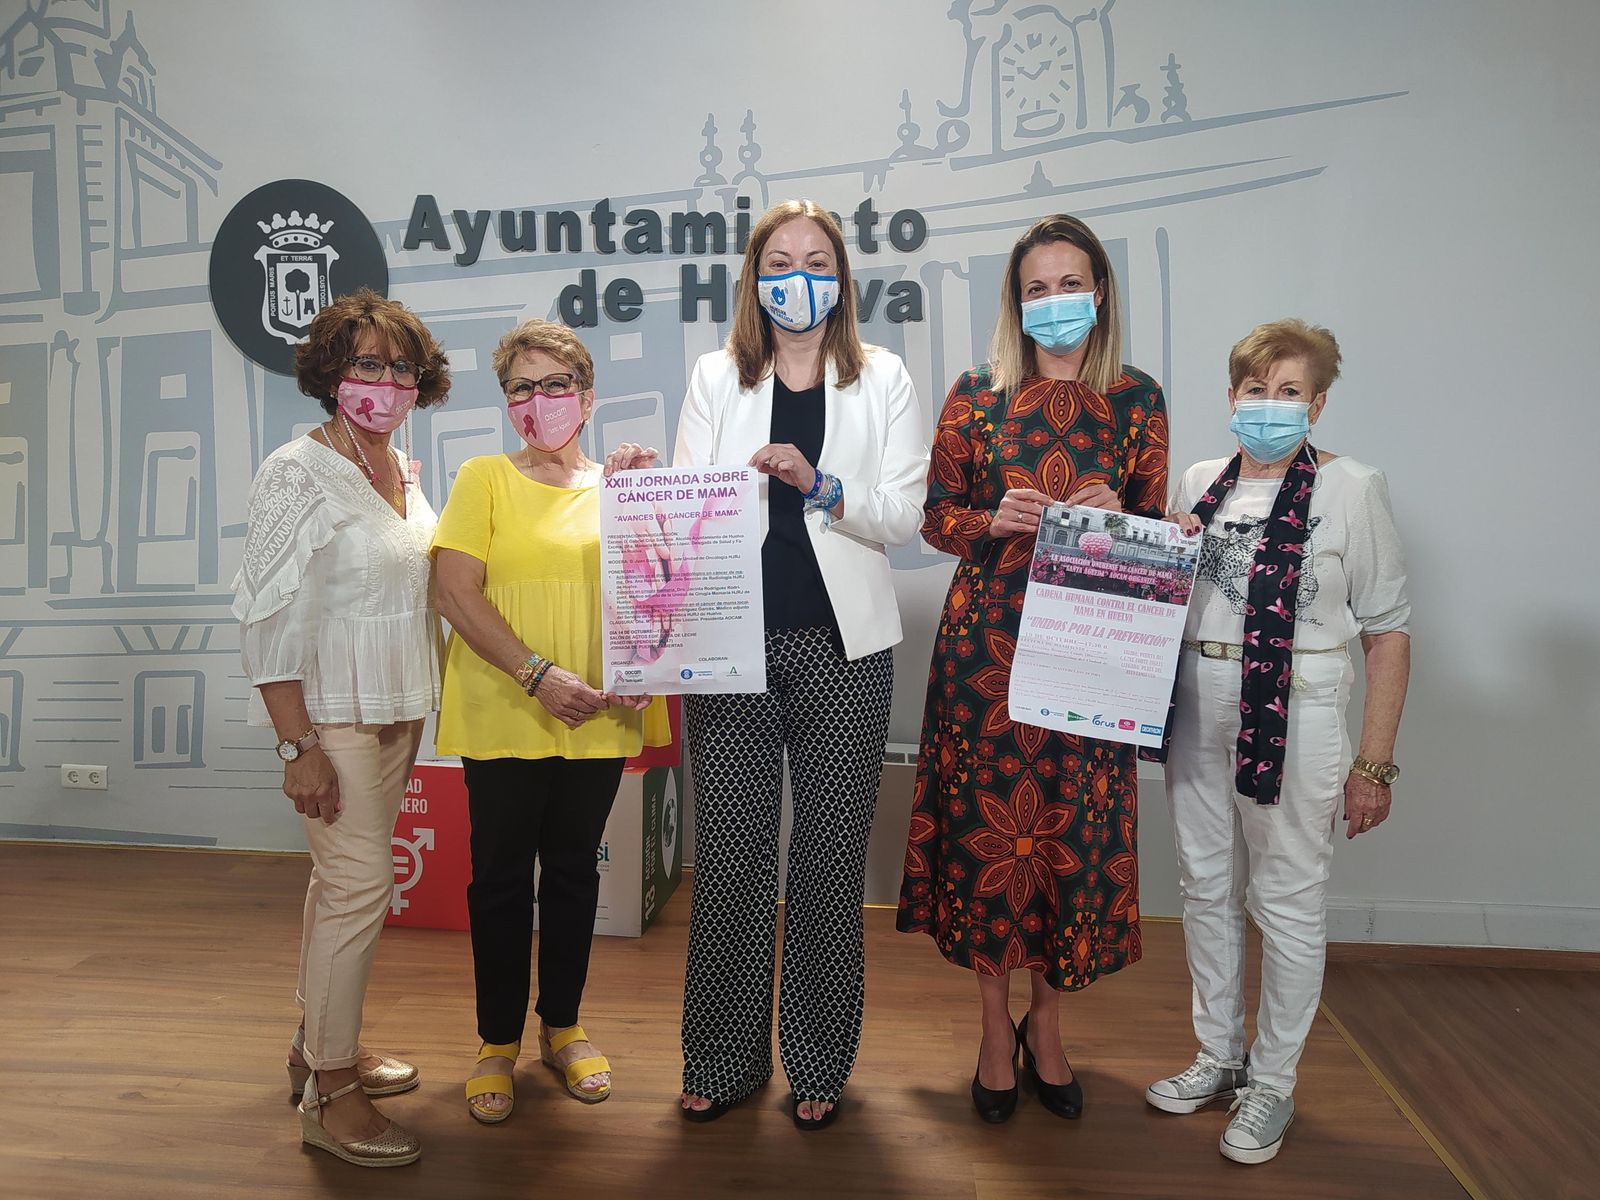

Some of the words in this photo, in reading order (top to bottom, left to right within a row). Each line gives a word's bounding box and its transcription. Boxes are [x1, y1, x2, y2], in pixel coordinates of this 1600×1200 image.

[402, 194, 927, 267] Ayuntamito
[557, 268, 644, 328] de
[681, 263, 923, 322] Hva
[636, 474, 700, 488] JORNADA
[703, 470, 749, 484] SOBRE
[617, 488, 673, 504] CÁNCER
[676, 489, 694, 501] DE
[698, 486, 737, 499] MAMA
[655, 513, 667, 521] EN
[668, 511, 701, 520] CÁNCER
[702, 510, 713, 518] DE
[1109, 571, 1128, 581] AOCAM
[1119, 565, 1127, 573] DE
[1036, 587, 1063, 601] CADENA
[1065, 592, 1095, 605] HUMANA
[1096, 597, 1125, 610] CONTRA
[1127, 602, 1136, 611] EL
[1165, 609, 1176, 618] DE
[1074, 605, 1094, 618] MAMA
[1096, 609, 1106, 620] EN
[1107, 611, 1133, 624] HUELVA
[1068, 623, 1092, 637] POR
[1092, 627, 1106, 639] LA
[1092, 713, 1117, 728] Forus
[644, 884, 656, 921] 13
